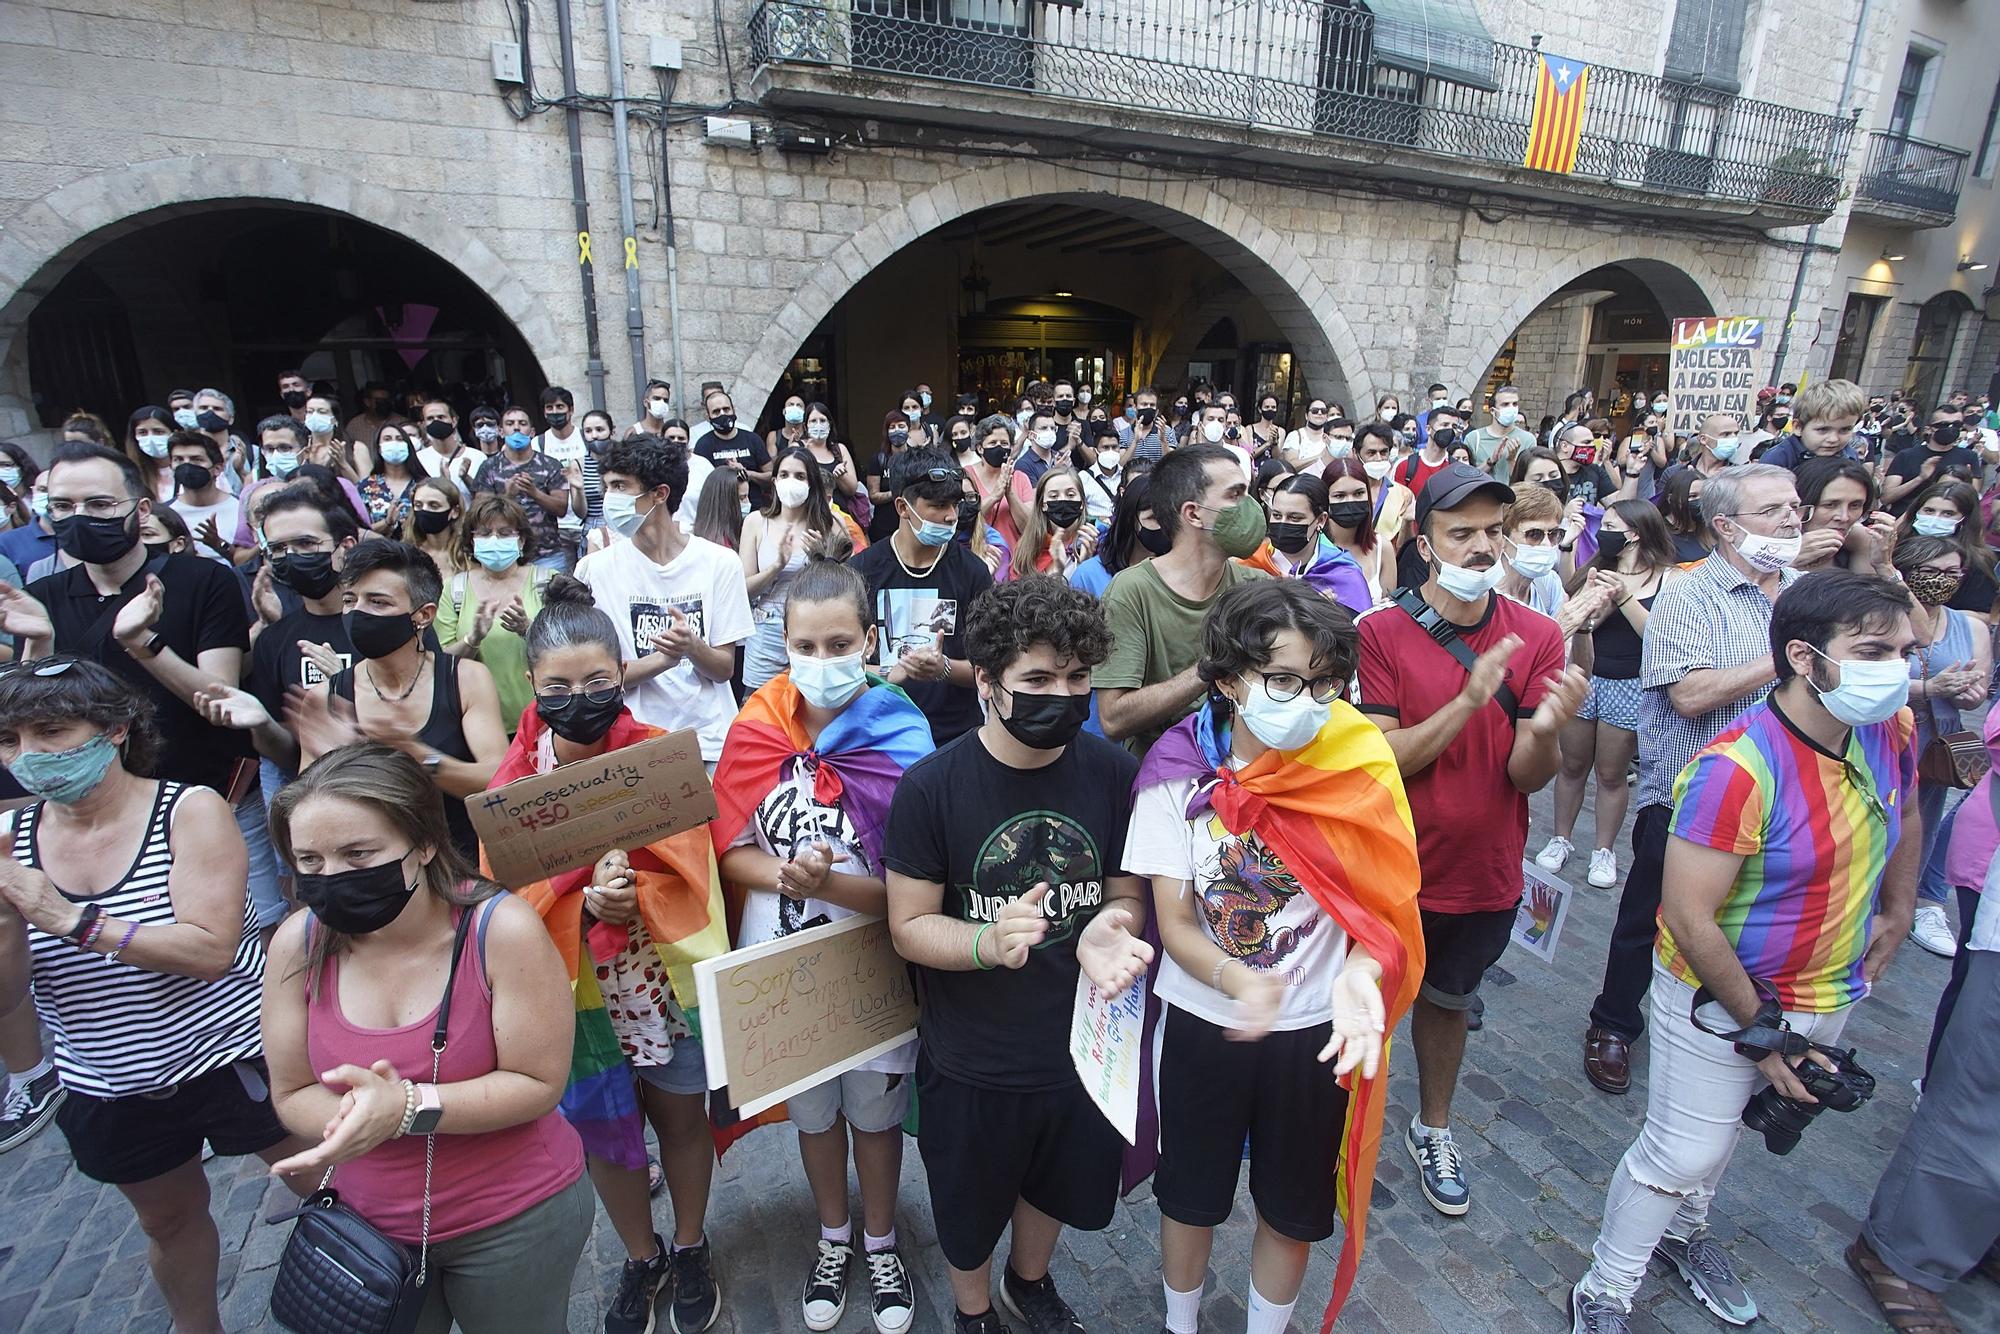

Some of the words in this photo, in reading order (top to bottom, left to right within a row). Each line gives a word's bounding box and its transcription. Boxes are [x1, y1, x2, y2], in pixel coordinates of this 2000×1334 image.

[1678, 320, 1708, 345] LA
[1715, 319, 1759, 345] LUZ
[1674, 348, 1752, 369] MOLESTA
[1674, 372, 1686, 389] A
[1690, 371, 1717, 389] LOS
[1722, 372, 1754, 389] QUE
[1674, 393, 1720, 412] VIVEN
[1724, 394, 1748, 412] EN
[1673, 413, 1691, 430] LA
[1754, 551, 1787, 566] SANITAT
[483, 764, 644, 820] Homosexuality
[648, 748, 689, 769] exists
[497, 825, 514, 838] in
[520, 804, 570, 833] 450
[574, 786, 638, 813] species
[614, 810, 628, 824] in
[680, 782, 699, 800] 1
[852, 957, 877, 985] to
[729, 963, 795, 1009] Sorry
[742, 1022, 821, 1078] Change
[818, 1003, 851, 1033] the
